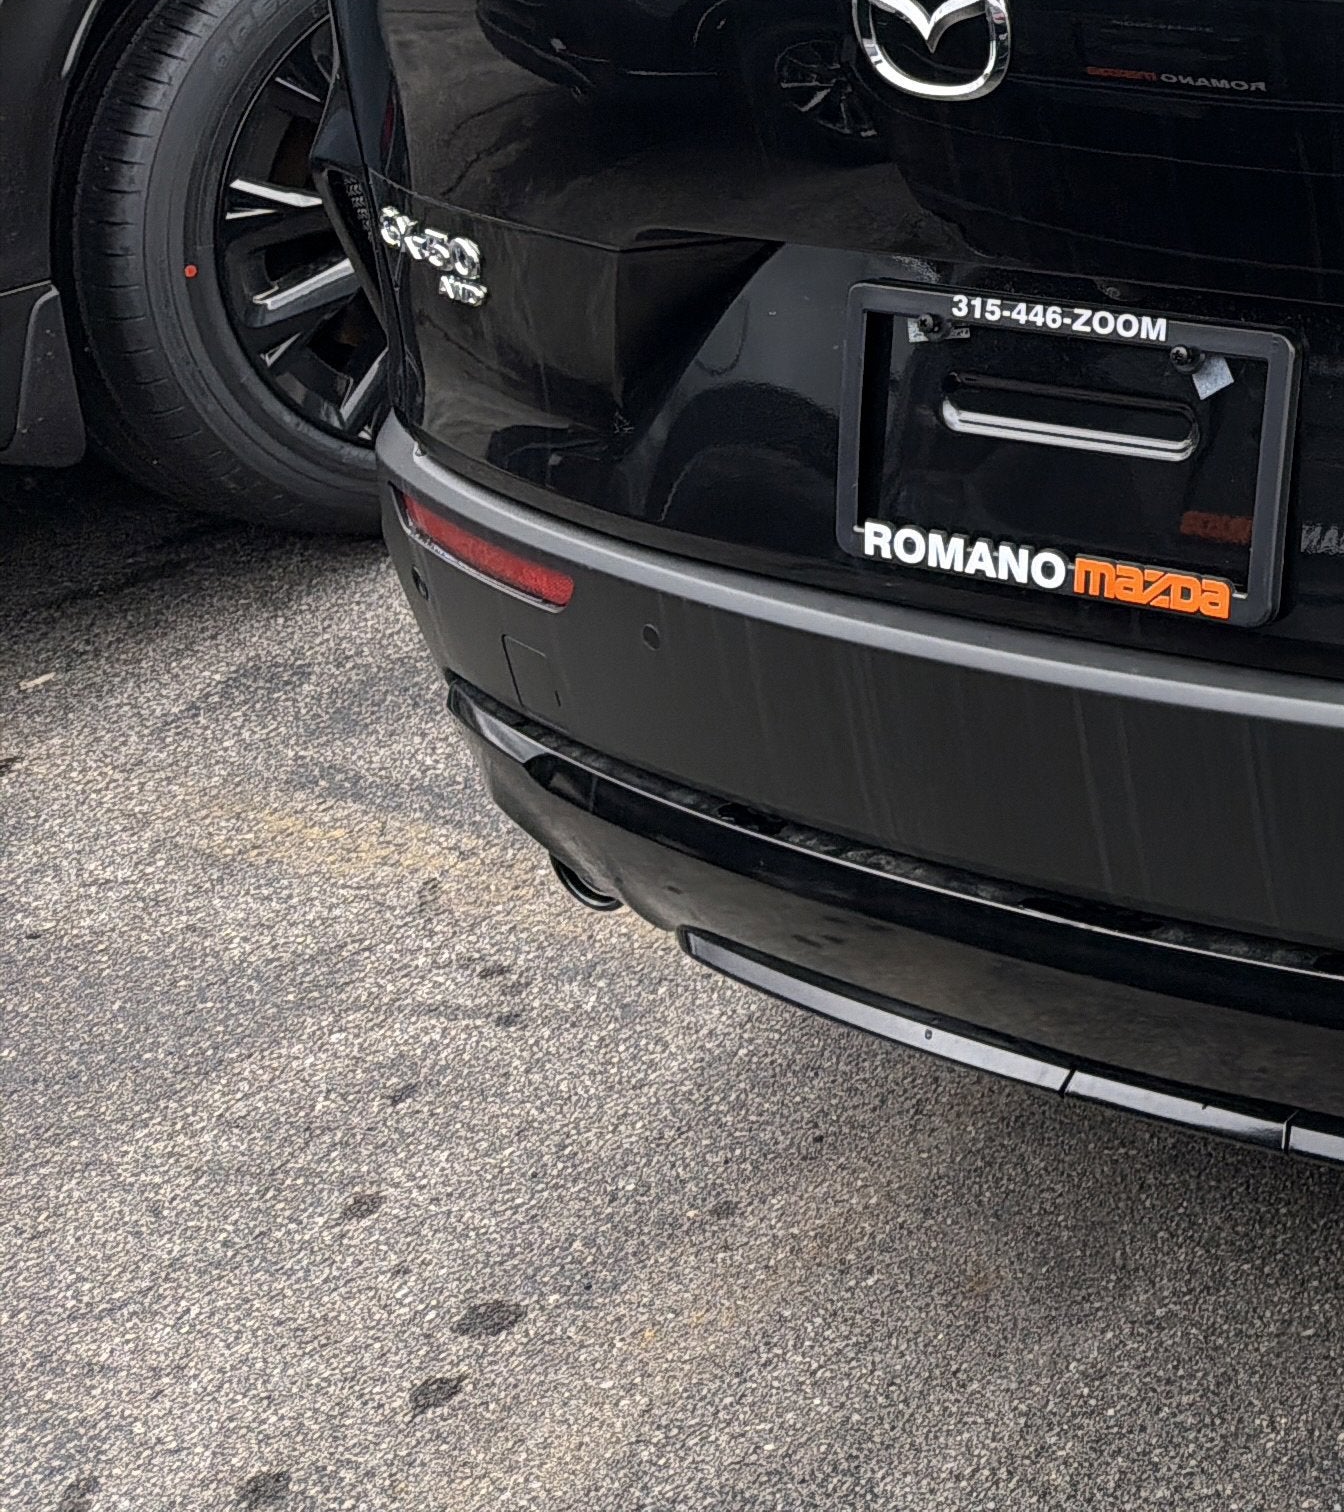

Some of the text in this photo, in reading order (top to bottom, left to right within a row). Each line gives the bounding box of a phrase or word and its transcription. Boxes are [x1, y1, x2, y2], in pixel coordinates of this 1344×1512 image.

[951, 294, 1168, 343] 315-446-ZOOM
[863, 521, 1232, 620] ROMANO mazda
